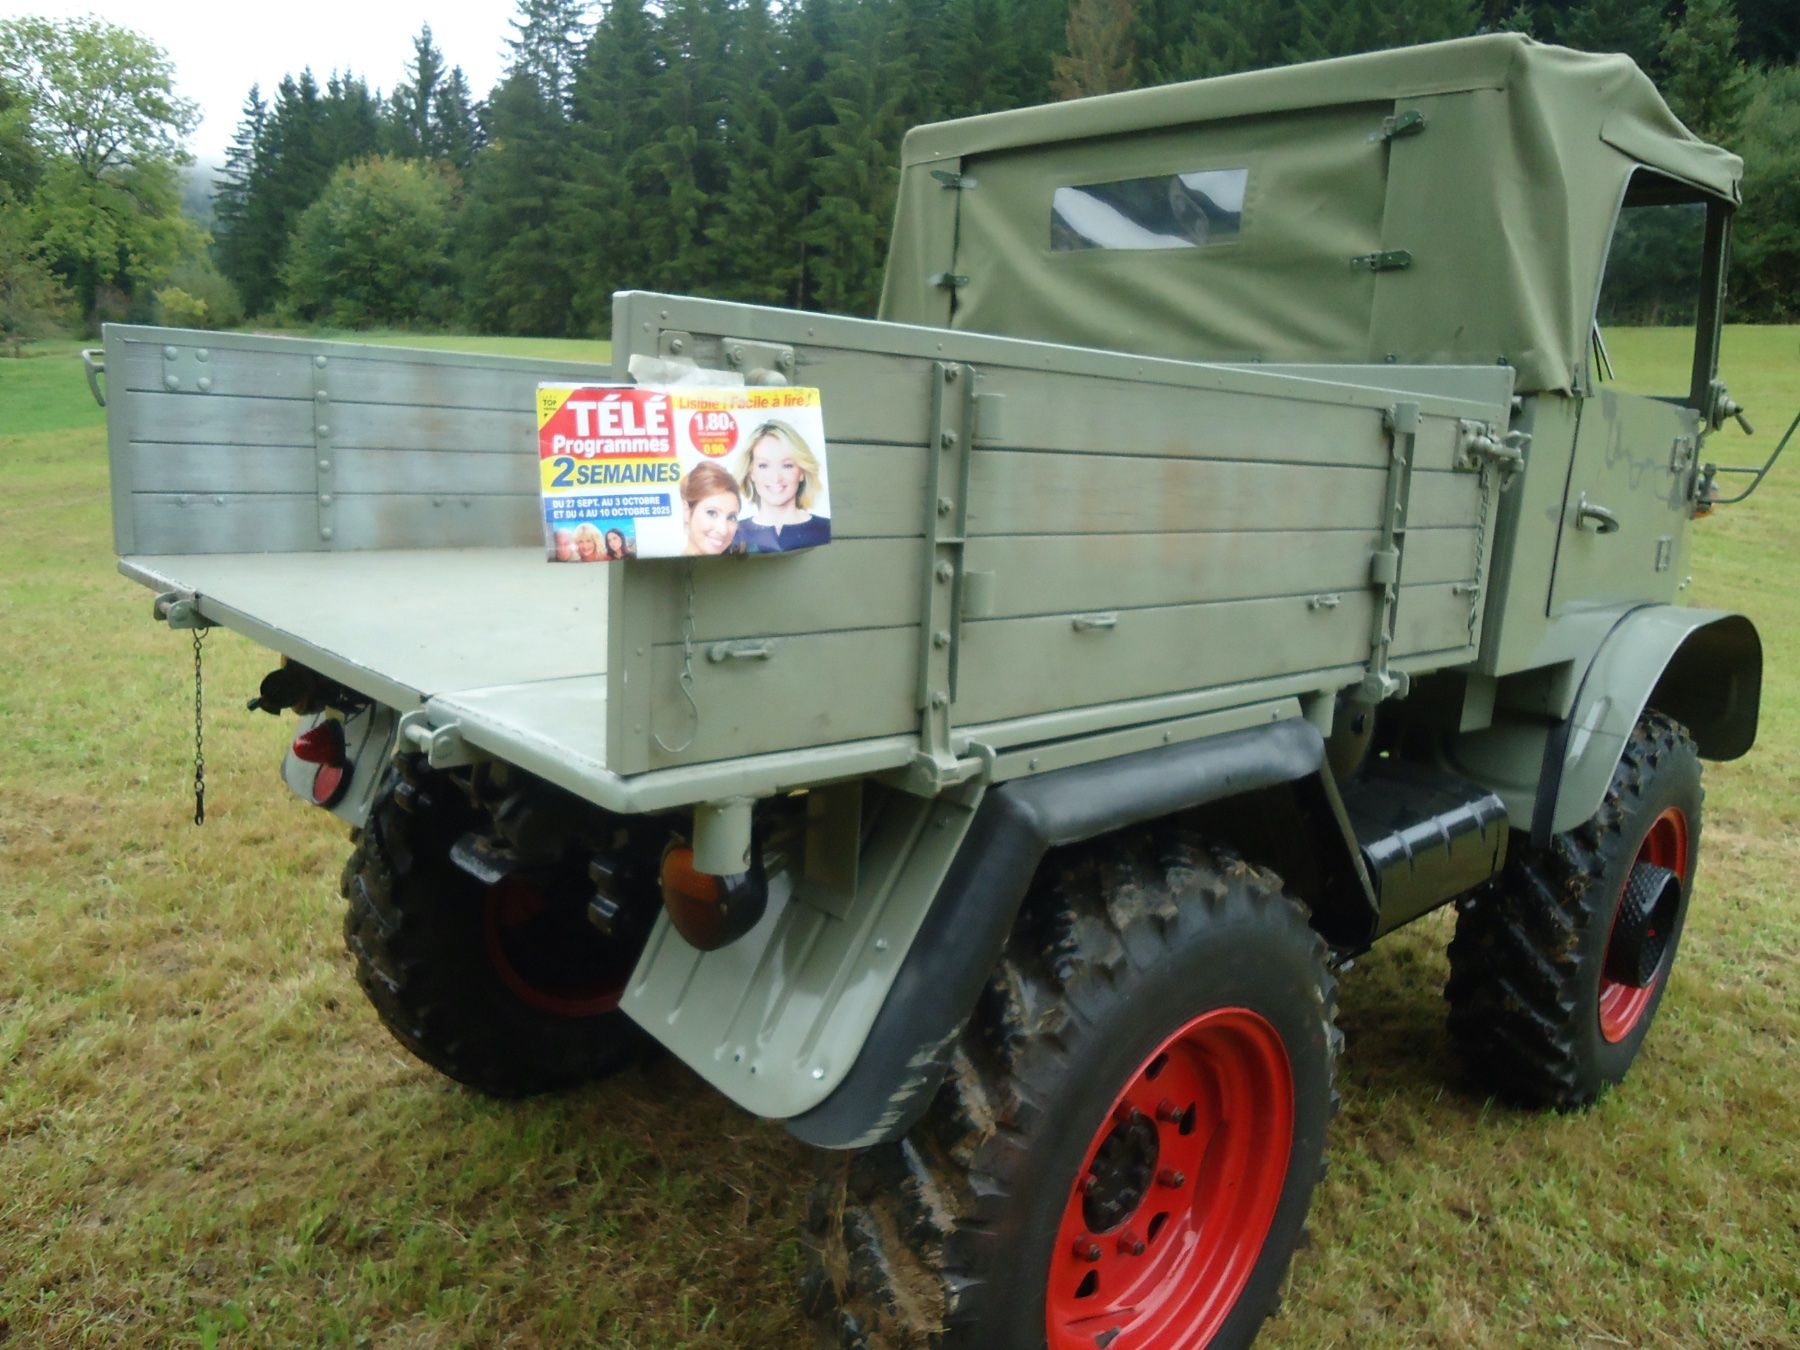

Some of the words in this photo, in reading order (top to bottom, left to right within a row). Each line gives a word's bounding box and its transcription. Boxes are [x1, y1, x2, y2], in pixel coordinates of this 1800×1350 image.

[566, 394, 669, 437] TÉLÉ
[552, 434, 669, 458] Programmes
[551, 457, 575, 487] 2
[577, 463, 680, 485] SEMAINES
[552, 499, 564, 509] DU
[566, 499, 575, 508] 27
[577, 498, 600, 507] SEPT.
[601, 498, 613, 507] AU
[615, 497, 621, 506] 3
[622, 496, 660, 506] OCTOBRE
[553, 509, 564, 519] ET
[566, 509, 577, 519] DU
[578, 509, 585, 518] 4
[586, 508, 598, 518] AU
[599, 508, 610, 517] 10
[611, 506, 650, 517] OCTOBRE
[651, 505, 671, 515] 2025
